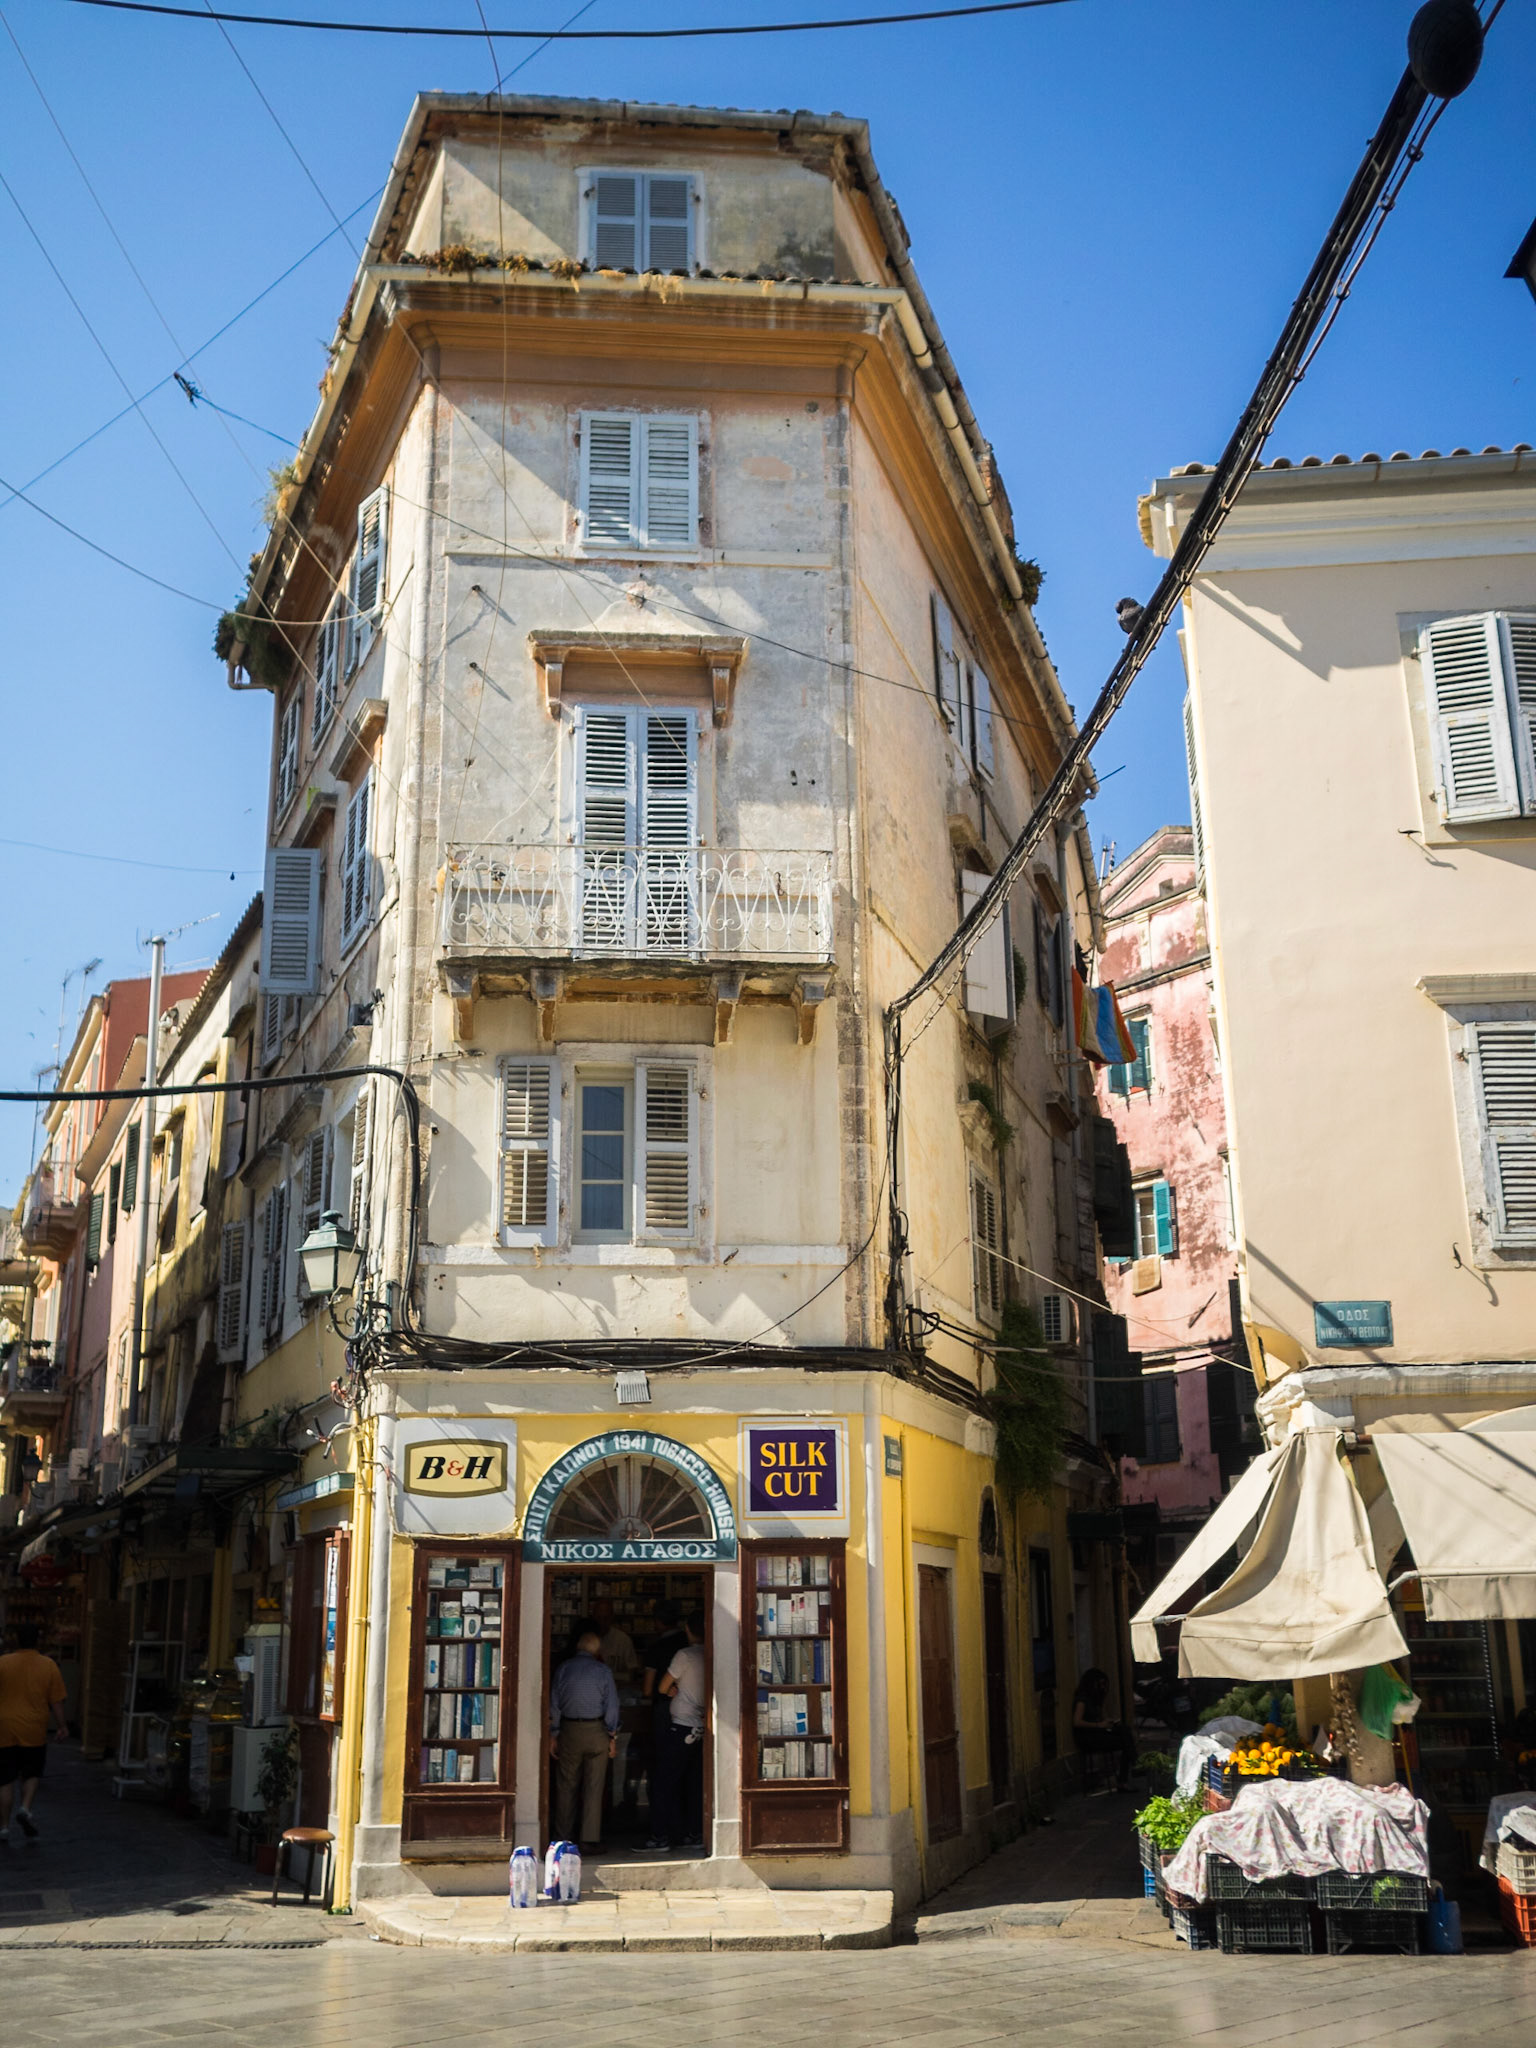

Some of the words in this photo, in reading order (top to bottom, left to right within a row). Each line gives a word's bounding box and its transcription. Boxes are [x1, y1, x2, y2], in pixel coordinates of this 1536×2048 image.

[1336, 1309, 1371, 1322] ΟΔΟΣ
[760, 1441, 828, 1468] SILK
[416, 1456, 495, 1480] B&H
[525, 1497, 549, 1542] ΣΠΙΤΙ
[542, 1439, 607, 1494] ΚΑΠΝΟΥ
[613, 1434, 647, 1451] 1941
[764, 1471, 823, 1498] CUT
[541, 1543, 614, 1559] ΝΙΚΟΣ
[622, 1542, 718, 1559] ΑΓΑΘΟΣ
